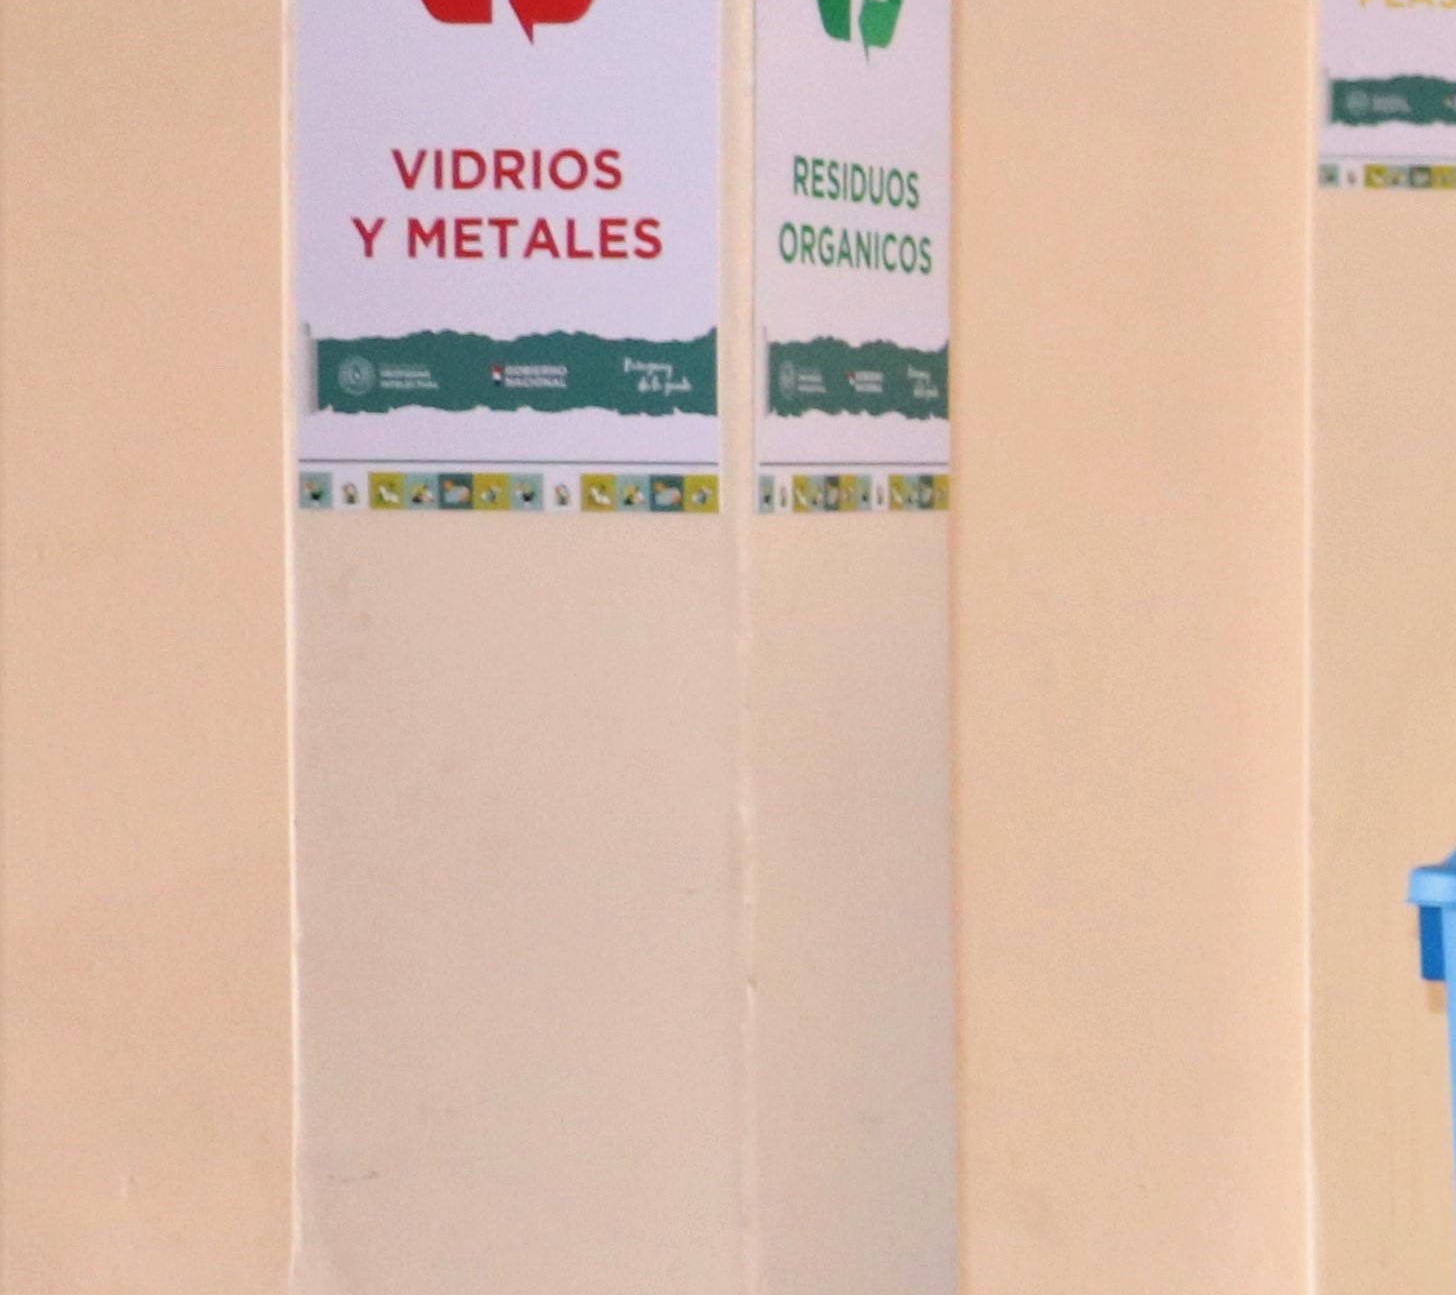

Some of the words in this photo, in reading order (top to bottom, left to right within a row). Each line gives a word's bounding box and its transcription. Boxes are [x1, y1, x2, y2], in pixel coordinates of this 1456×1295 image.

[391, 148, 624, 191] VIDRIOS
[793, 154, 920, 210] RESIDUOS
[351, 217, 386, 259] Y
[407, 217, 663, 260] METALES
[778, 221, 933, 275] ORGANICOS
